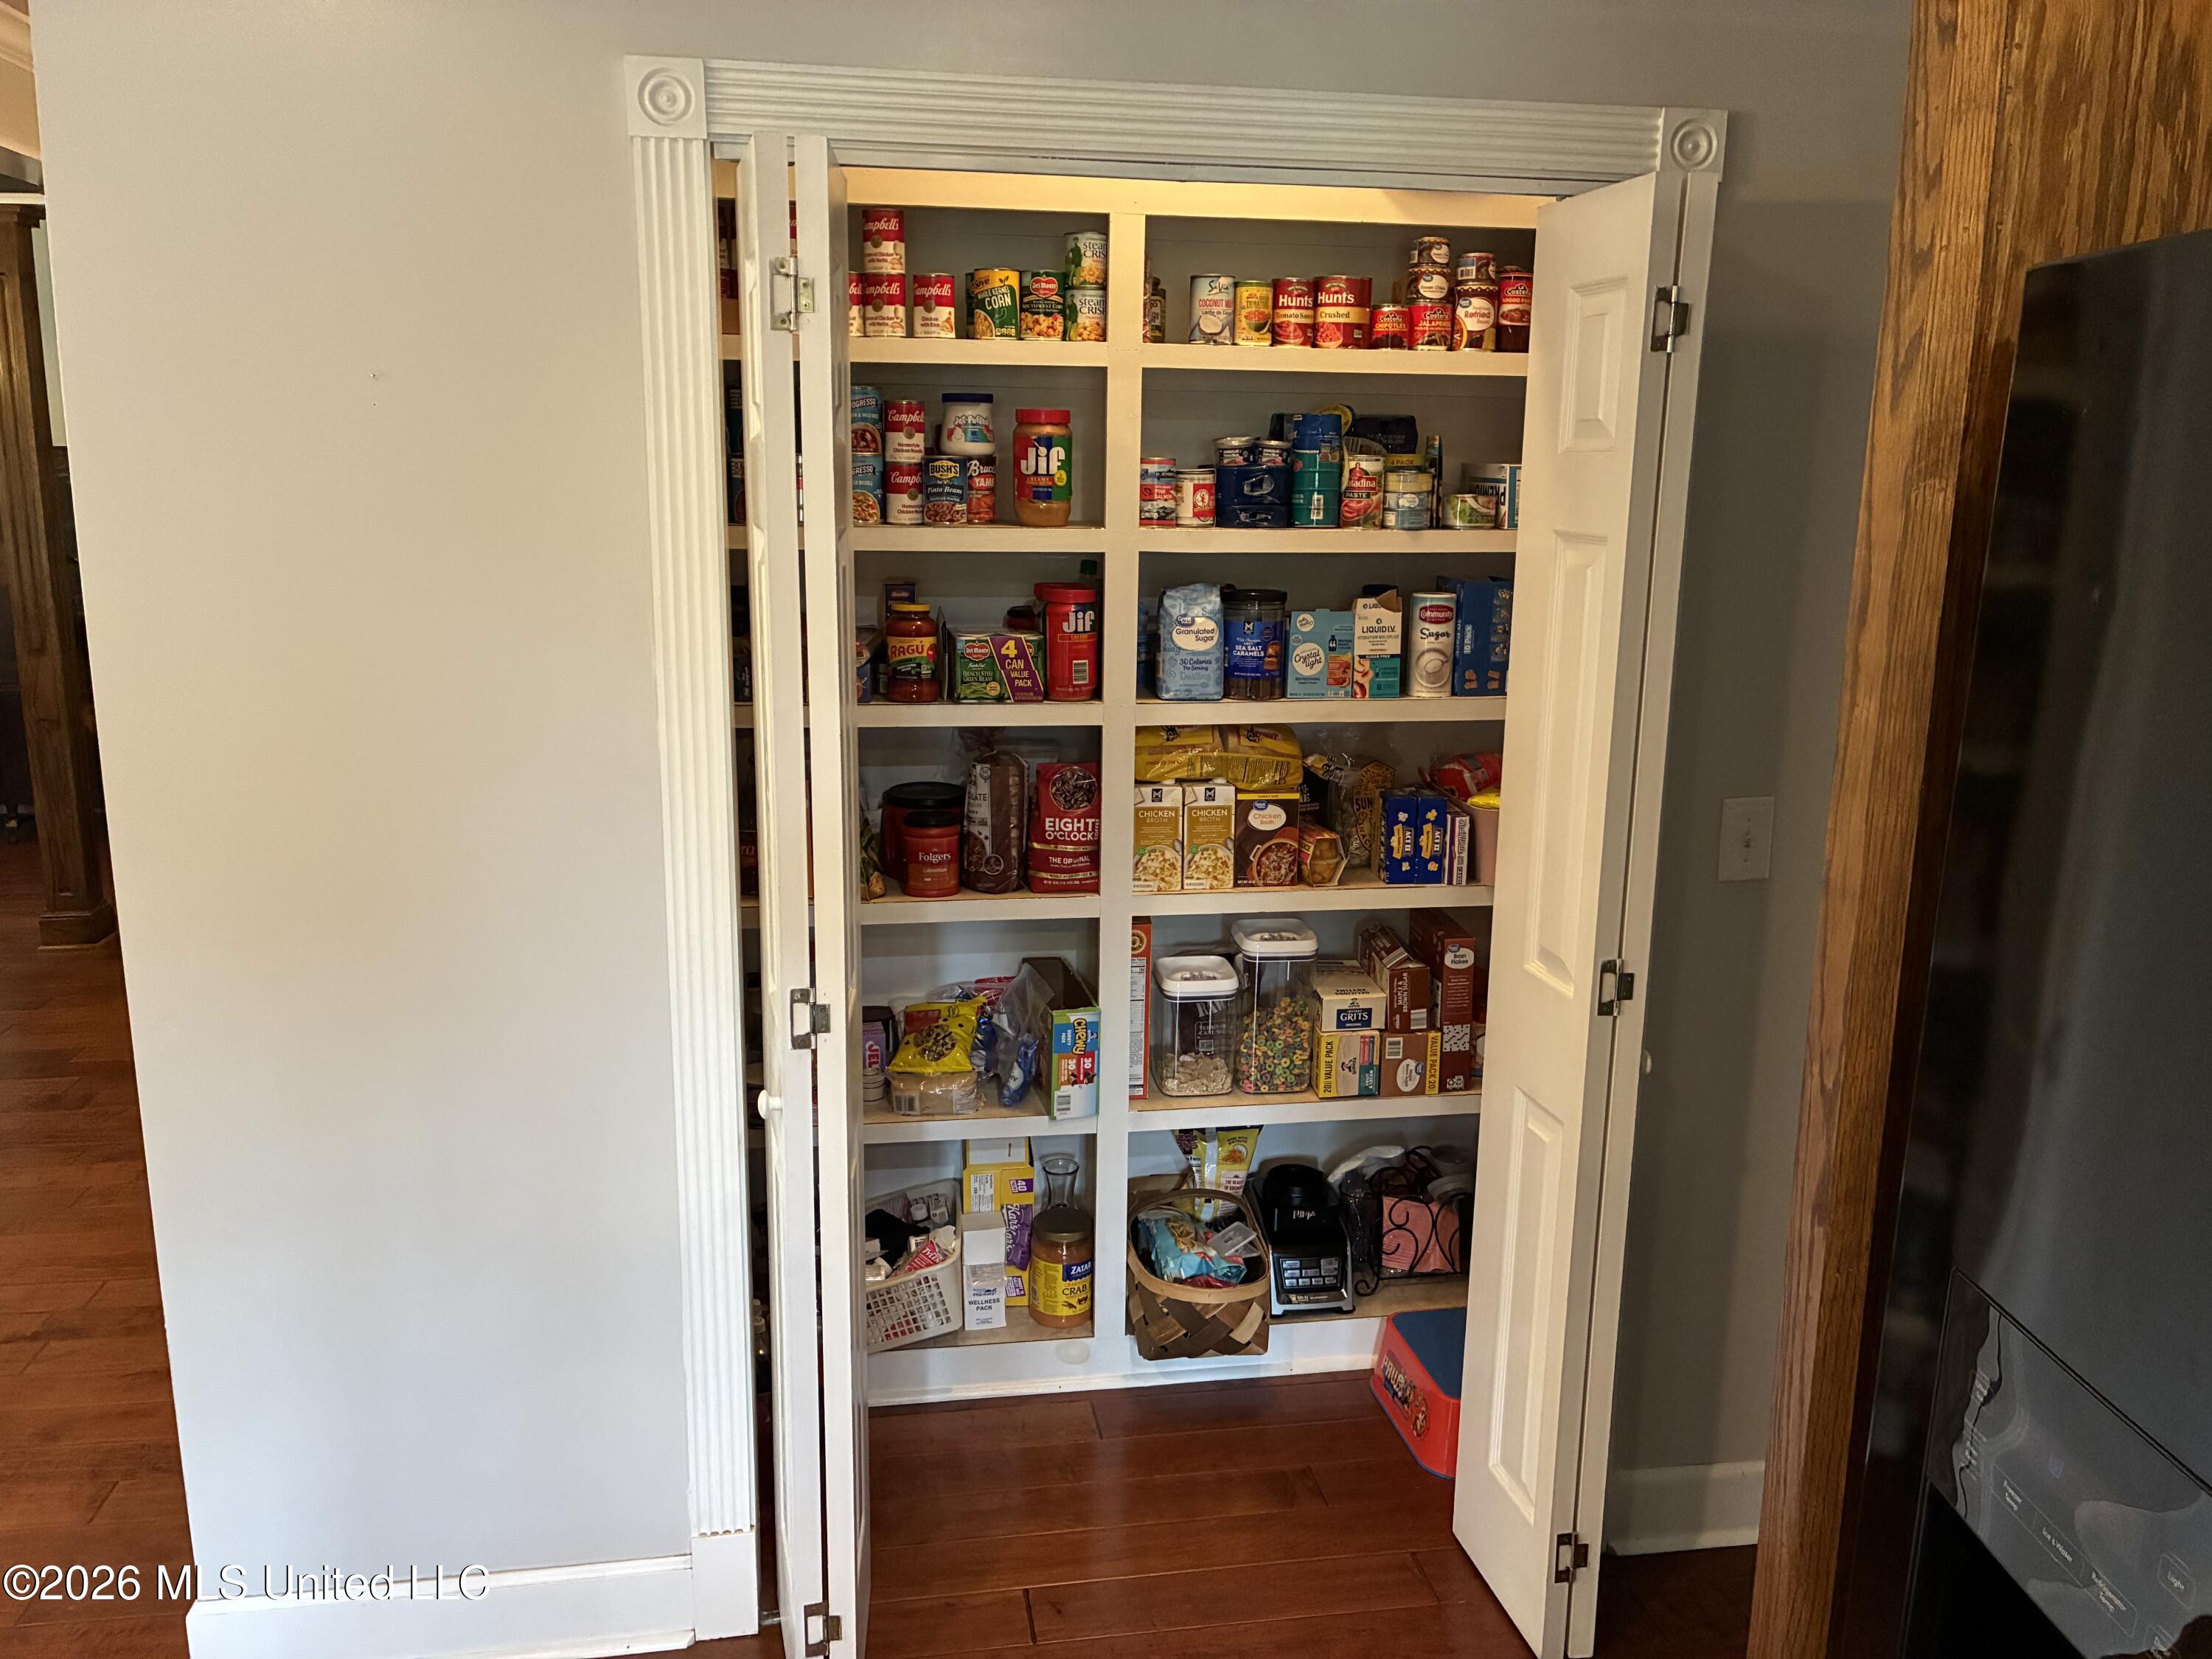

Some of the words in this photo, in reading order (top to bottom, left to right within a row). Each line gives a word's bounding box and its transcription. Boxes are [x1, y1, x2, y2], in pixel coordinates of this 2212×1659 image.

[1083, 249, 1107, 259] CRIS
[984, 293, 1012, 310] CORN
[1198, 298, 1224, 308] COCONUT
[1320, 310, 1351, 319] Crushed
[1464, 310, 1491, 319] Refried
[852, 397, 877, 408] OGRESSO
[887, 409, 924, 425] Campbel
[1020, 446, 1065, 476] Jif
[852, 465, 874, 476] GRESSO
[930, 464, 959, 476] BUSH'S
[890, 471, 922, 487] Campb
[975, 477, 995, 487] YAMS
[1349, 479, 1377, 488] tadina
[944, 486, 963, 495] Beans
[1420, 609, 1453, 619] Community
[1062, 610, 1096, 634] Jif
[1175, 627, 1216, 636] Granulated
[1361, 625, 1386, 634] LIQUID
[1419, 627, 1451, 641] Sugar
[1464, 625, 1472, 644] Pack
[1194, 634, 1215, 643] Sugar
[1001, 639, 1018, 658] 4
[1294, 650, 1321, 664] Crystal
[1005, 659, 1024, 669] CAN
[1305, 658, 1324, 669] light
[1015, 679, 1032, 687] PACK
[967, 793, 988, 802] OLATE
[1191, 809, 1228, 817] CHICKEN
[1045, 817, 1093, 832] EIGHT
[1045, 831, 1094, 841] O'CLOCK
[918, 852, 951, 863] Folgers
[1048, 856, 1061, 864] THE
[1340, 1012, 1368, 1022] GRITS
[1325, 1041, 1334, 1058] PACK
[1430, 1035, 1439, 1057] VALUE
[866, 1041, 880, 1069] JEL
[1068, 1059, 1076, 1070] 30
[1084, 1057, 1092, 1068] 30
[1324, 1060, 1332, 1080] VALUE
[1429, 1059, 1437, 1079] PACK
[1324, 1085, 1332, 1093] 20
[1428, 1080, 1436, 1089] 20
[1018, 1180, 1026, 1192] 40
[922, 1248, 941, 1264] TYLEN
[1071, 1262, 1091, 1275] ZATAR
[1062, 1284, 1088, 1295] CRAB
[2055, 1541, 2073, 1563] Water
[2167, 1570, 2185, 1592] Light
